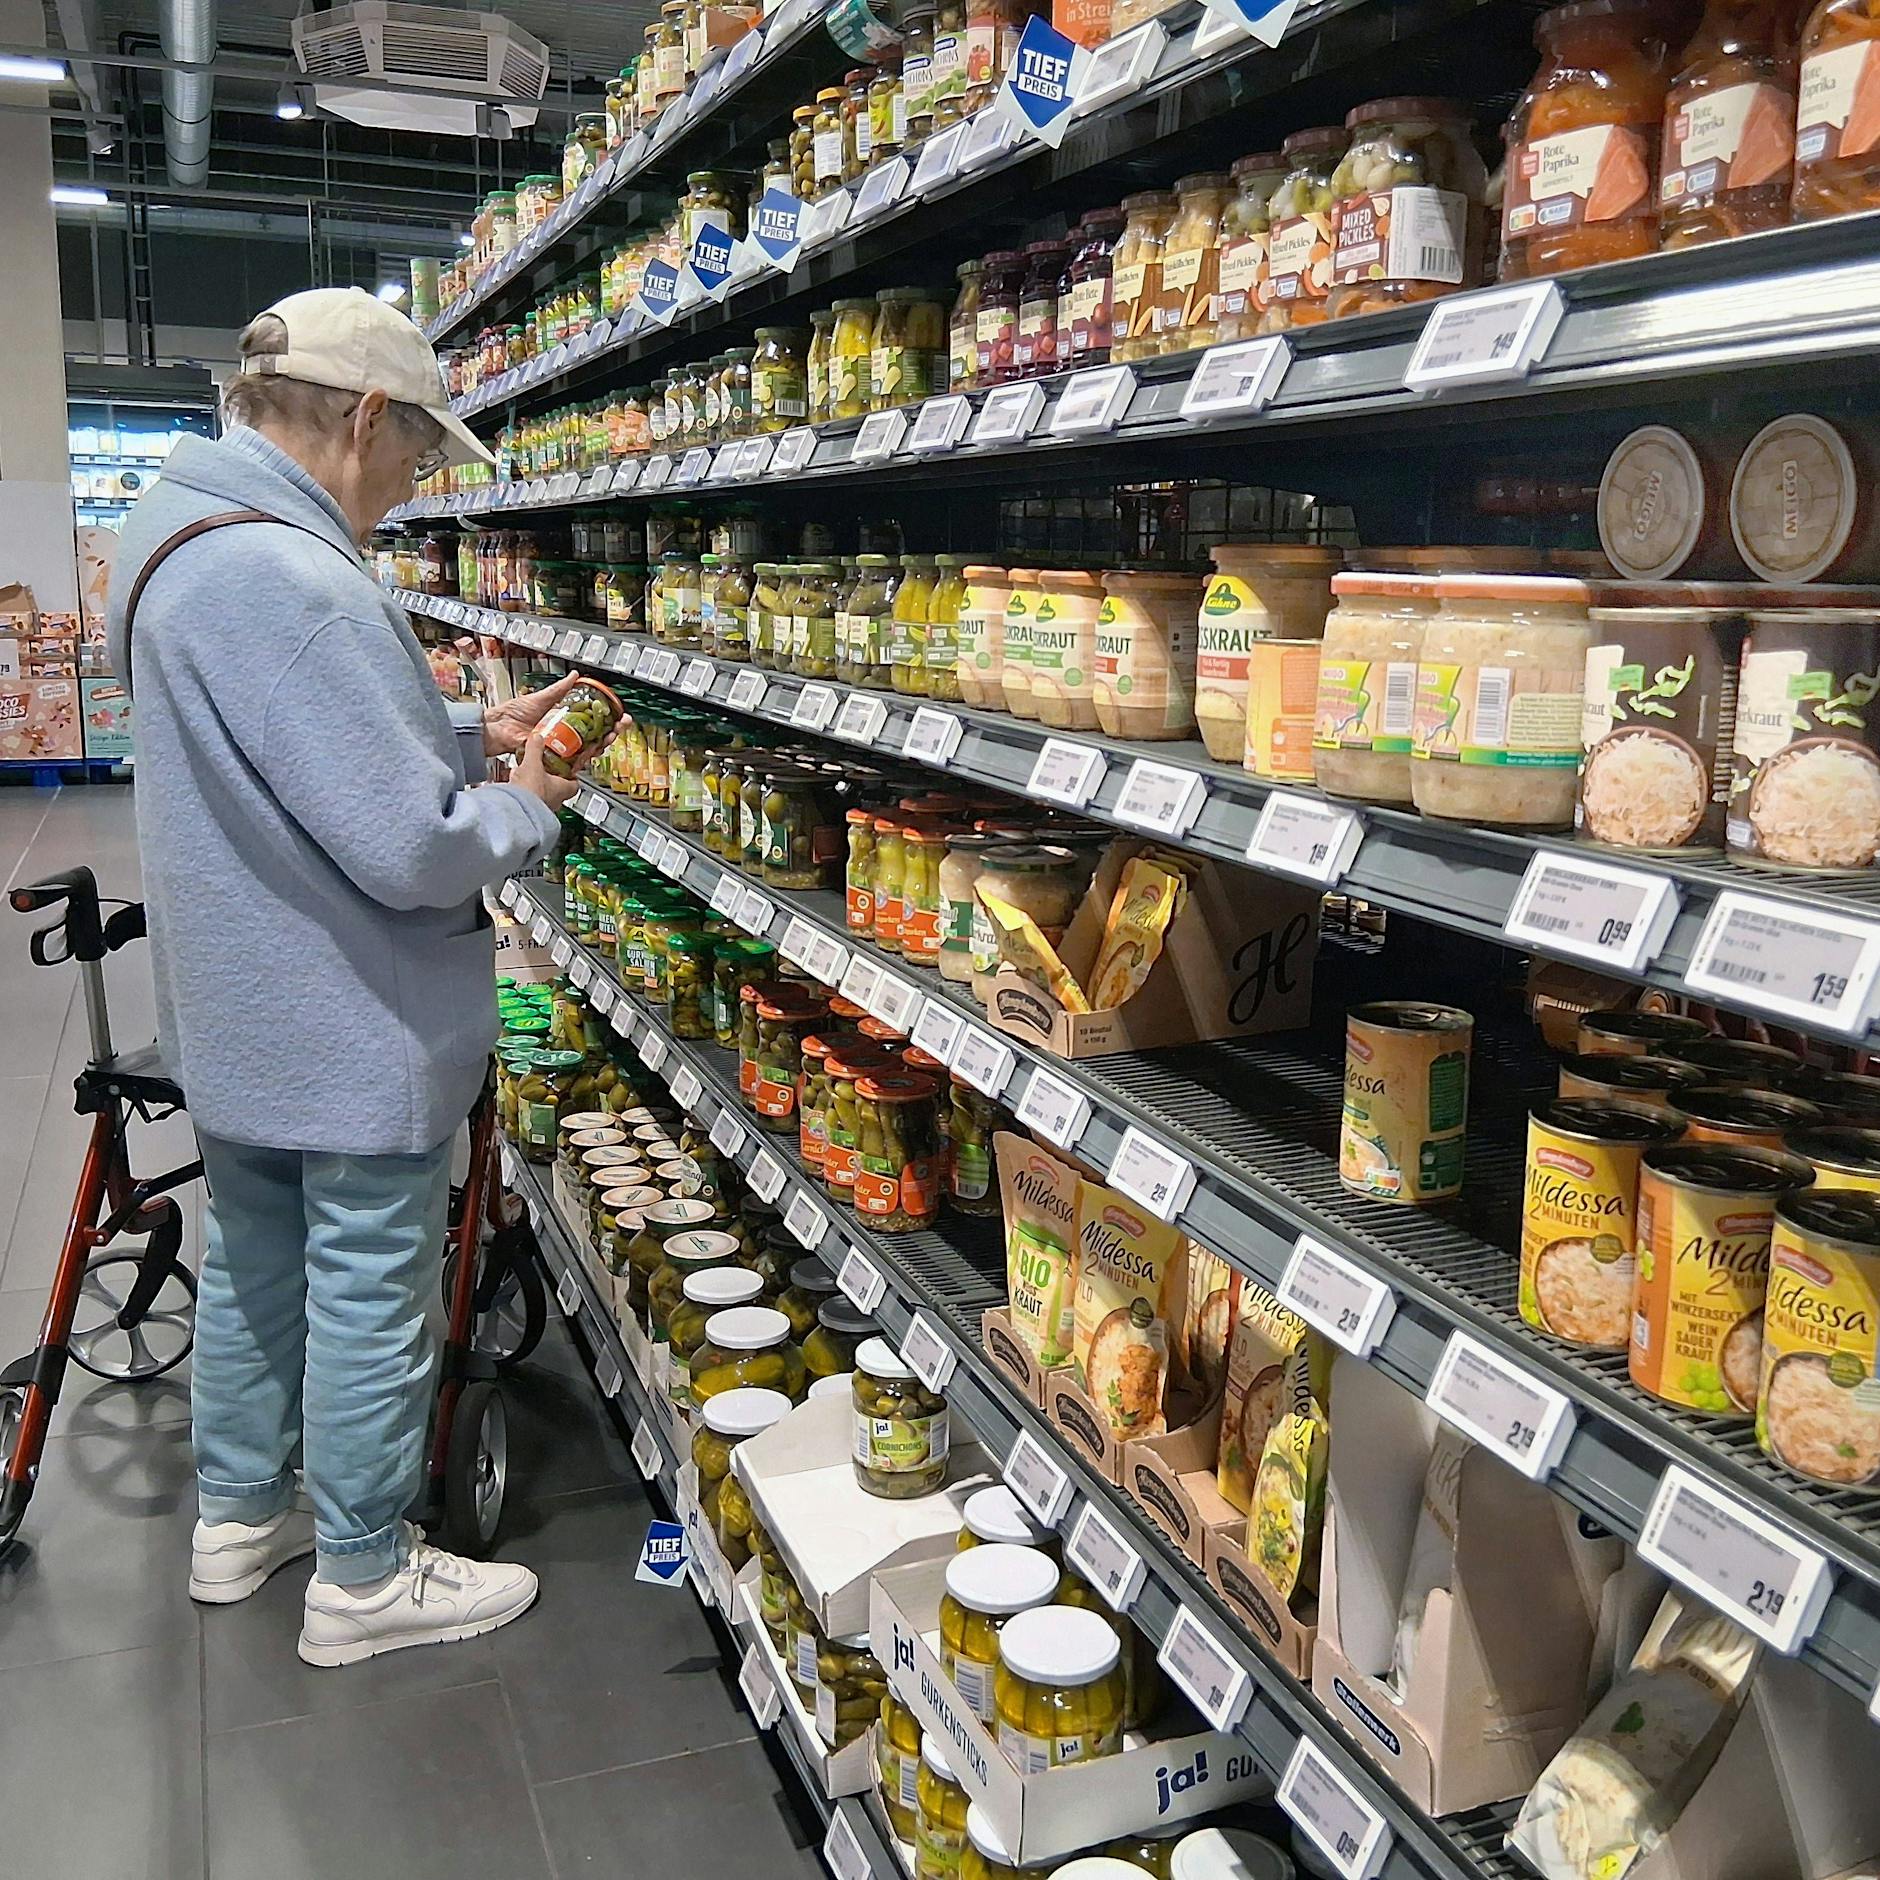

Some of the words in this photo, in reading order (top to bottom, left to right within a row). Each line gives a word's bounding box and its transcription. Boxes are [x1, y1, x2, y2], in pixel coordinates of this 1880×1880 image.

[1022, 48, 1068, 82] TIEF
[1024, 77, 1058, 98] PREIS
[1543, 143, 1565, 159] Rote
[1543, 153, 1580, 173] Paprika
[762, 208, 797, 228] TIEF
[1341, 208, 1372, 231] MIXED
[764, 227, 790, 240] PREIS
[1338, 224, 1375, 249] PICKLES
[698, 242, 729, 263] TIEF
[699, 258, 722, 273] PREIS
[646, 273, 675, 291] TIEF
[1013, 1169, 1074, 1225] Mildessa
[1542, 1204, 1601, 1230] MINUTEN
[1080, 1219, 1157, 1284] Mildessa
[1019, 1248, 1052, 1289] BIO
[1085, 1251, 1099, 1278] 2
[1098, 1260, 1140, 1291] MINUTEN
[1704, 1268, 1731, 1297] 2
[1014, 1286, 1043, 1318] KRAUT
[1679, 1290, 1698, 1304] MIT
[1240, 1302, 1260, 1329] 2
[1671, 1299, 1743, 1323] WINZERSEKT
[1675, 1330, 1715, 1350] SAUER
[1686, 1320, 1720, 1337] WEIN
[1776, 1312, 1840, 1347] MINUTEN
[1675, 1343, 1714, 1363] KRAUT
[875, 1422, 889, 1436] ja!
[648, 1537, 681, 1553] TIEF
[893, 1621, 916, 1673] ja!
[920, 1670, 989, 1788] GURKENSTICKS
[1335, 1681, 1398, 1752] Stollenwerk
[1059, 1740, 1080, 1759] ja!
[1155, 1749, 1210, 1817] ja!
